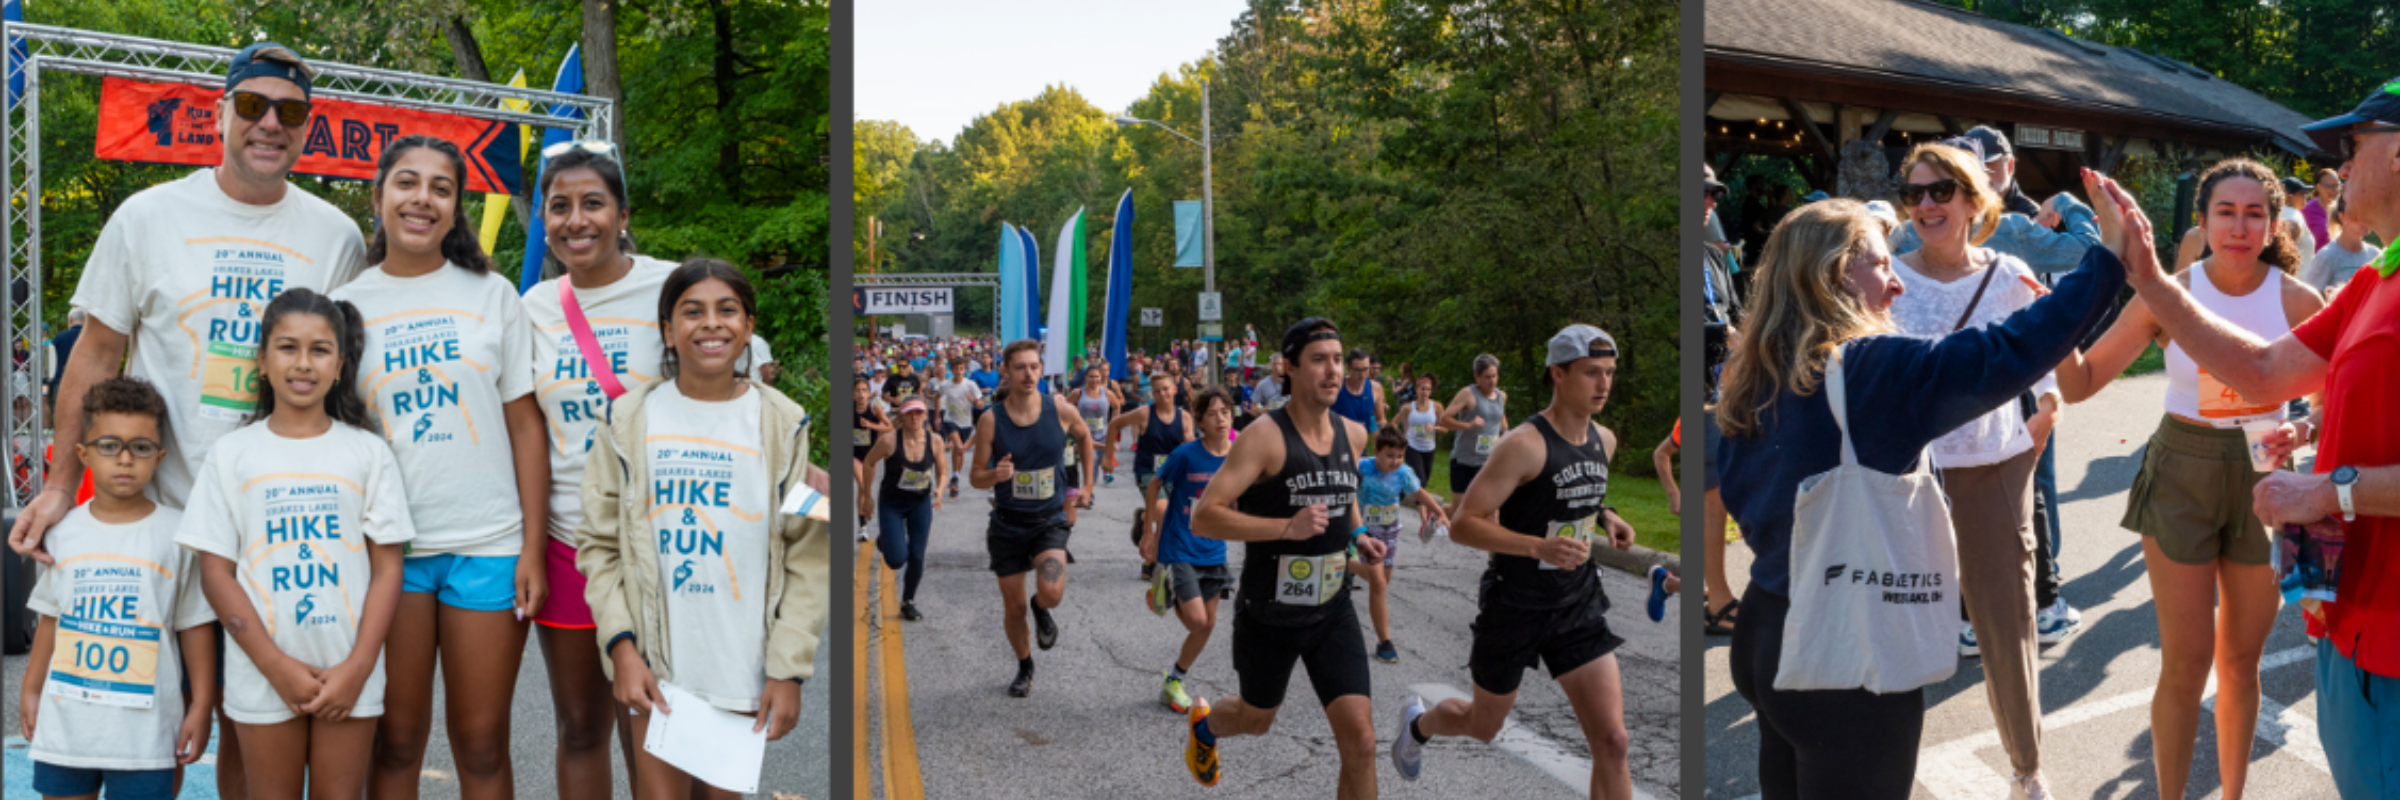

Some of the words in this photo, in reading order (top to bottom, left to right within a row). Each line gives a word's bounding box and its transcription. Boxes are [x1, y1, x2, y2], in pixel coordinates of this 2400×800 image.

[178, 132, 214, 145] LAND
[238, 250, 285, 262] ANNUAL
[210, 275, 285, 300] HIKE
[872, 291, 948, 306] FINISH
[238, 302, 252, 318] &
[407, 315, 456, 331] ANNUAL
[384, 339, 461, 373] HIKE
[554, 351, 629, 380] HIE
[417, 367, 433, 384] &
[585, 380, 601, 395] &
[392, 382, 459, 416] RUN
[560, 397, 602, 423] RU
[681, 449, 734, 461] ANNUAL
[1285, 471, 1325, 493] SOLE
[1552, 461, 1583, 488] SOLE
[288, 484, 340, 496] ANNUAL
[655, 479, 731, 507] HIKE
[681, 507, 697, 525] &
[265, 514, 341, 545] HIKE
[298, 542, 313, 560] &
[659, 528, 724, 557] RUN
[94, 567, 141, 577] ANNUAL
[272, 562, 339, 592] RUN
[1851, 569, 1943, 588] FABLETICS
[1283, 581, 1314, 598] 264
[73, 595, 139, 620] HIKE
[310, 615, 337, 625] 2024
[74, 640, 130, 674] 100
